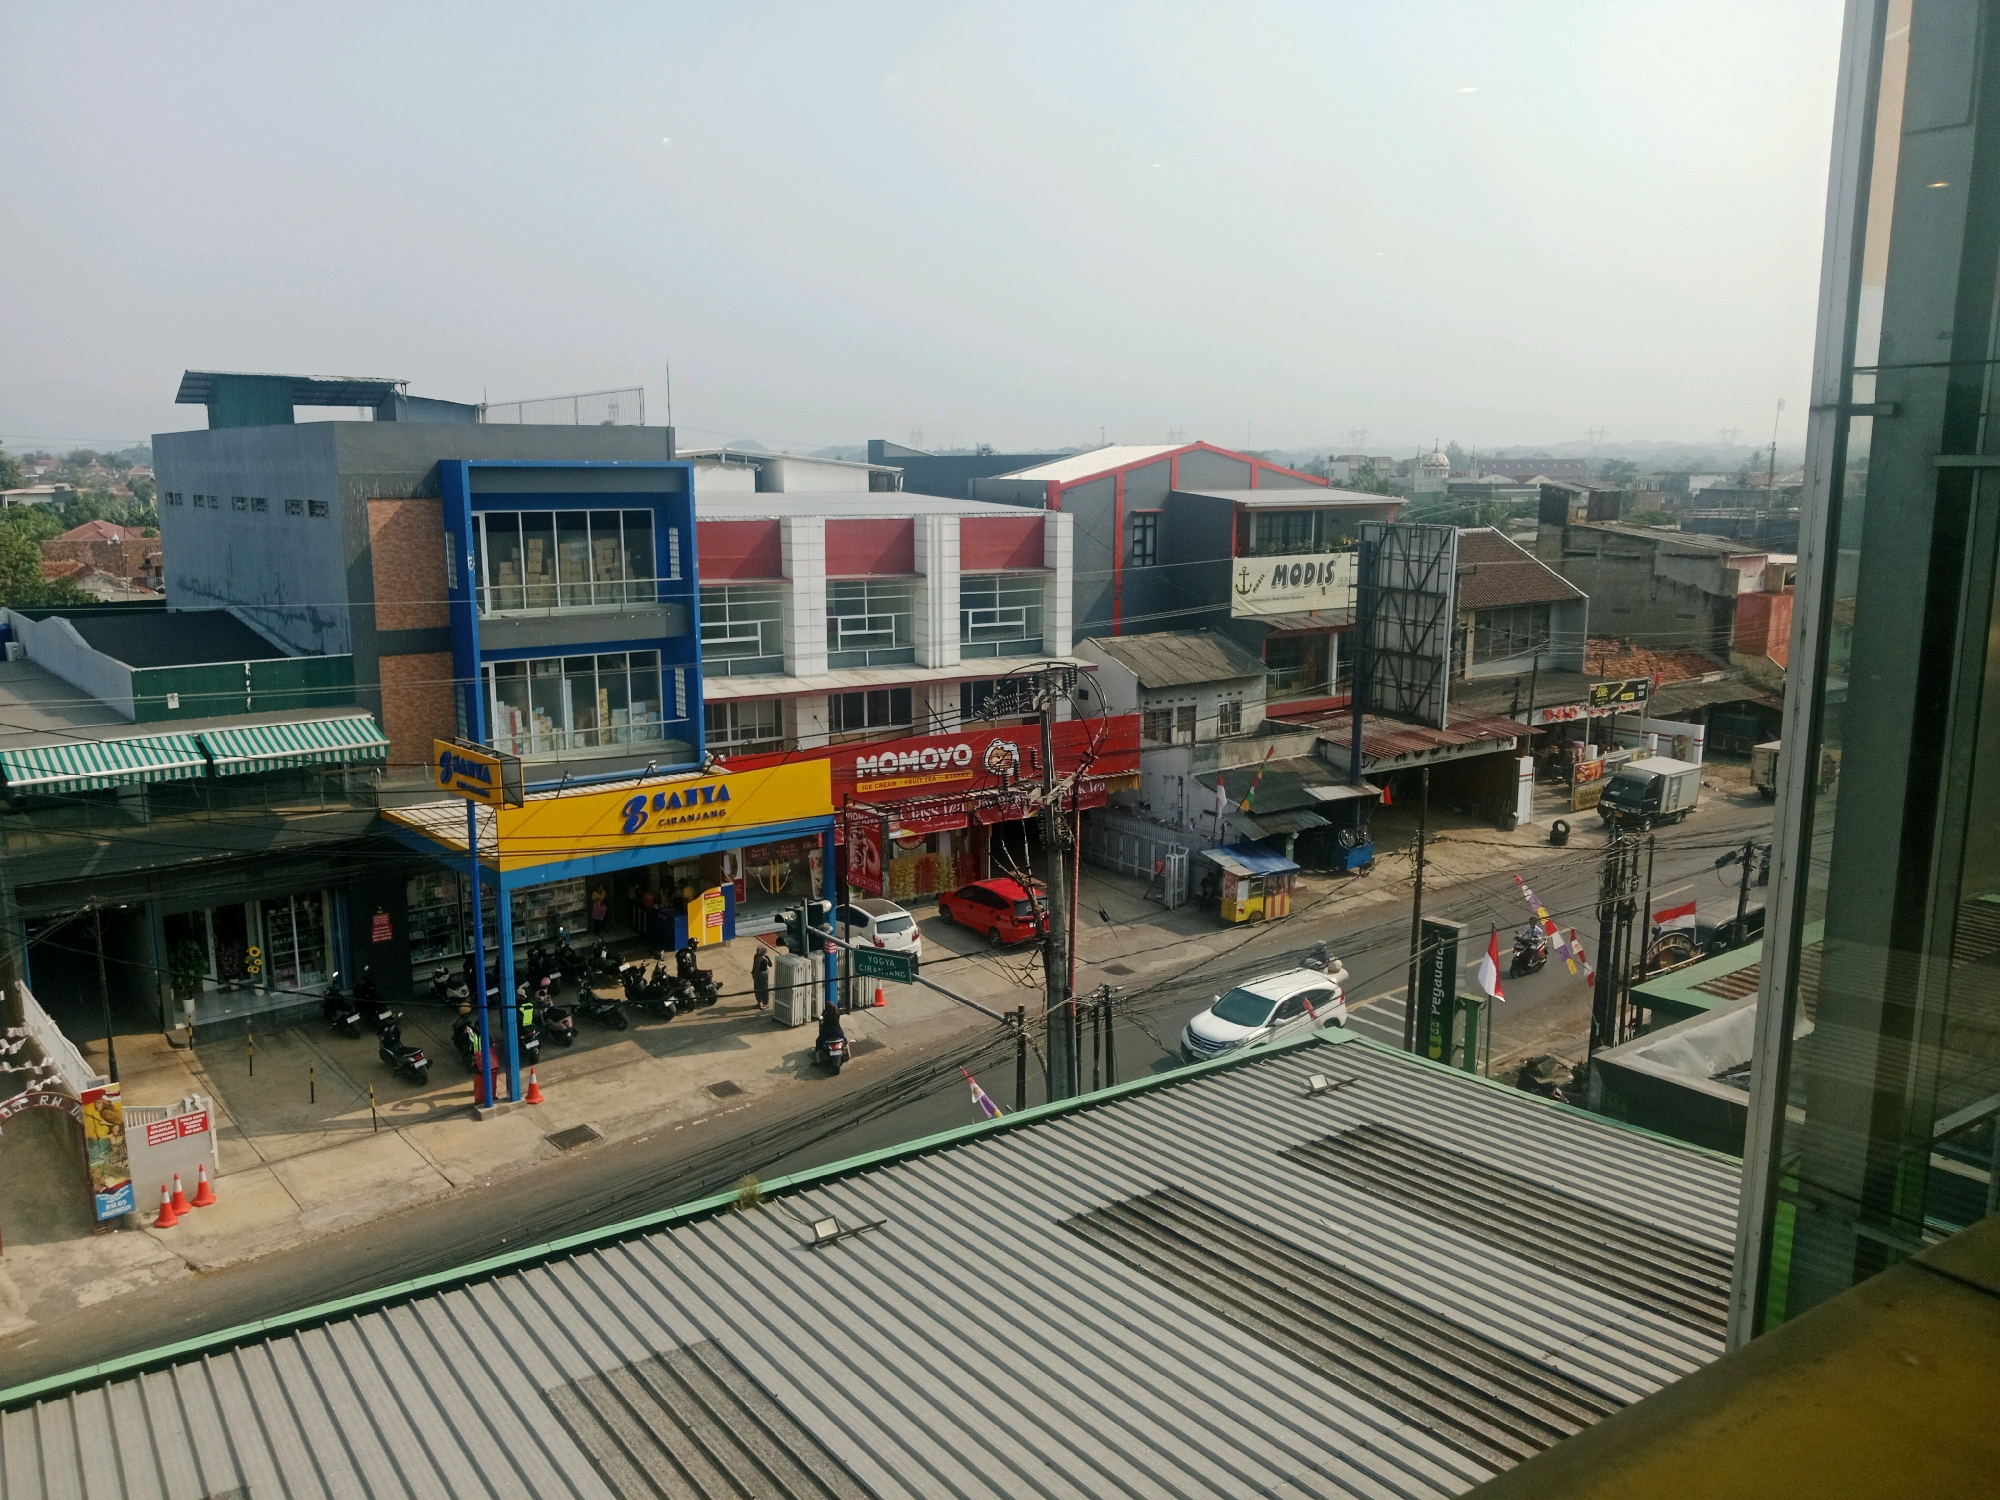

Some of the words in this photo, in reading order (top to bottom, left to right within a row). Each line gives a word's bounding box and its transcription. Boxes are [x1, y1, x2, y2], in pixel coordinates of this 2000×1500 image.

[1271, 560, 1336, 589] MODIS
[856, 743, 973, 778] MOMOYO
[874, 781, 897, 789] CREAM
[652, 784, 731, 812] SANYA
[658, 808, 727, 827] CIRANJANG
[868, 955, 895, 967] YOGYA
[858, 963, 906, 979] CIRANJANG
[40, 1094, 62, 1107] RW
